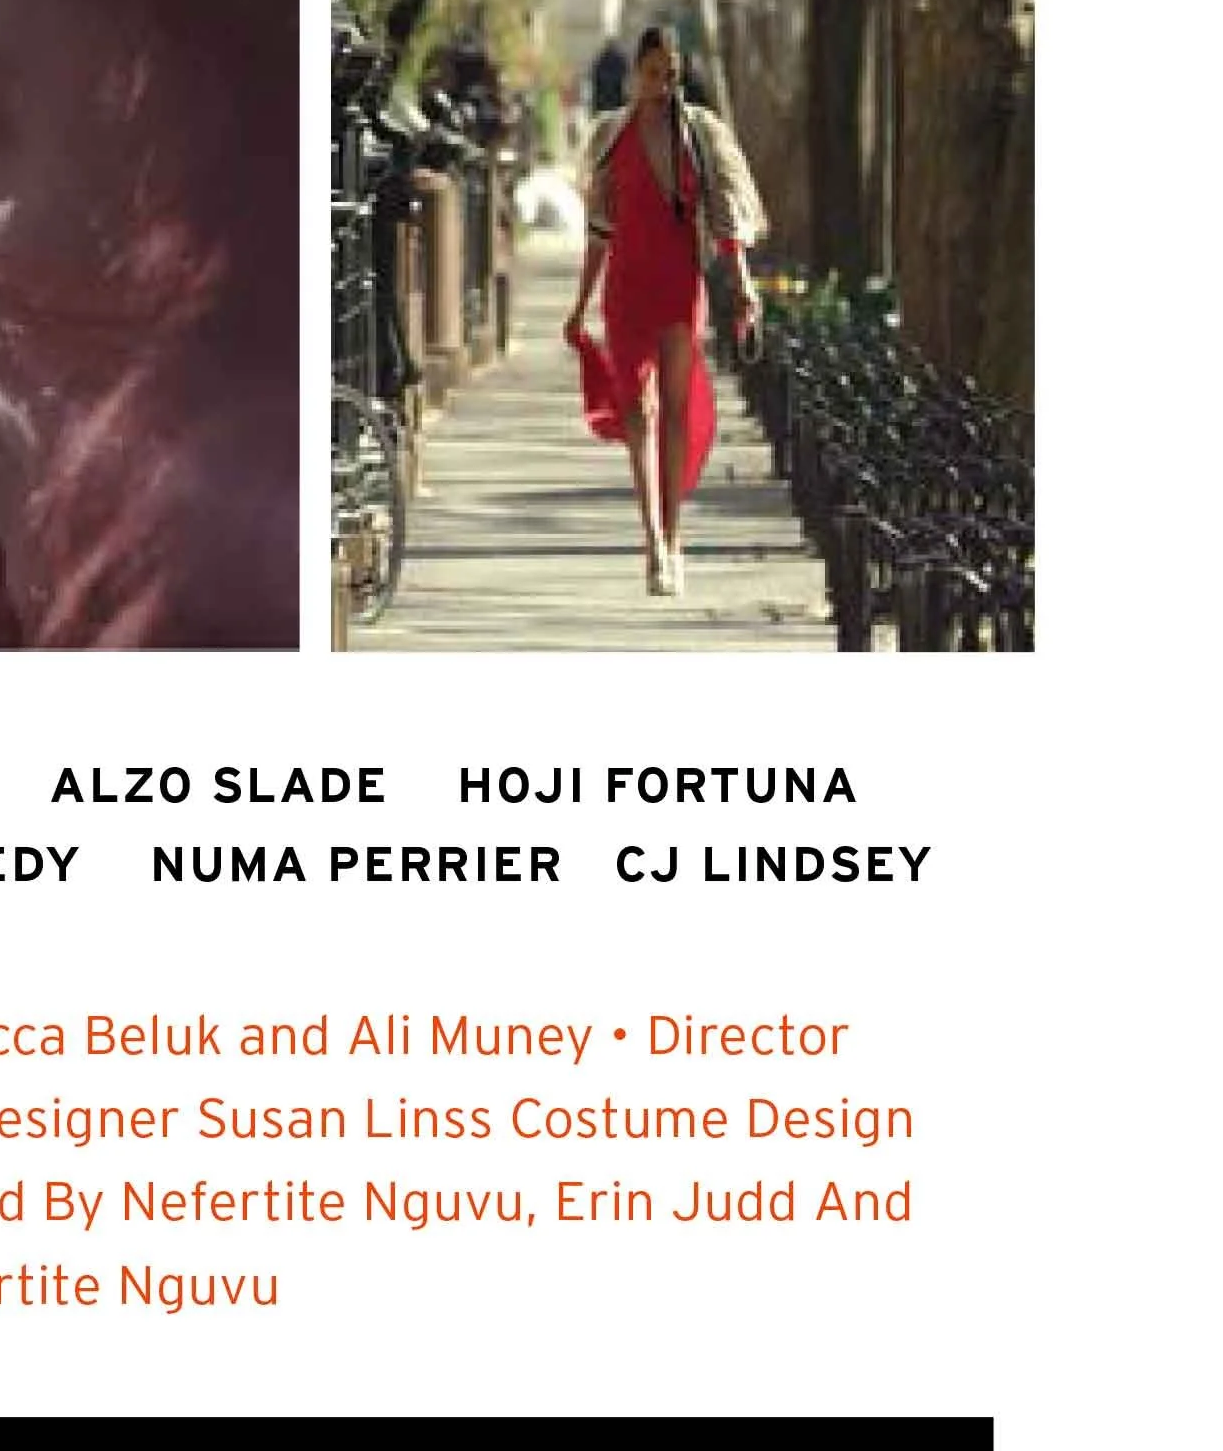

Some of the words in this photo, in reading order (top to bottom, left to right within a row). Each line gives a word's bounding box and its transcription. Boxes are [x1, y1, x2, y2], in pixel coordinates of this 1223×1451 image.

[51, 767, 190, 803] ALZO
[214, 767, 384, 803] SLADE
[461, 767, 580, 803] HOJI
[608, 767, 856, 803] FORTUNA
[154, 847, 306, 882] NUMA
[331, 847, 559, 881] PERRIER
[617, 846, 677, 882] CJ
[705, 846, 931, 882] LINDSEY
[88, 1015, 220, 1055] Beluk
[241, 1015, 327, 1055] and
[349, 1014, 409, 1054] Ali
[433, 1016, 592, 1064] Muney
[651, 1015, 848, 1055] Director
[200, 1098, 344, 1138] Susan
[368, 1098, 490, 1138] Linss
[513, 1098, 727, 1138] Costume
[750, 1098, 911, 1147] Design
[47, 1182, 103, 1231] By
[125, 1180, 344, 1221] Nefertite
[367, 1182, 534, 1230] Nguvu,
[559, 1181, 651, 1220] Erin
[673, 1181, 793, 1221] Judd
[816, 1180, 909, 1221] And
[122, 1266, 276, 1314] Nguvu
